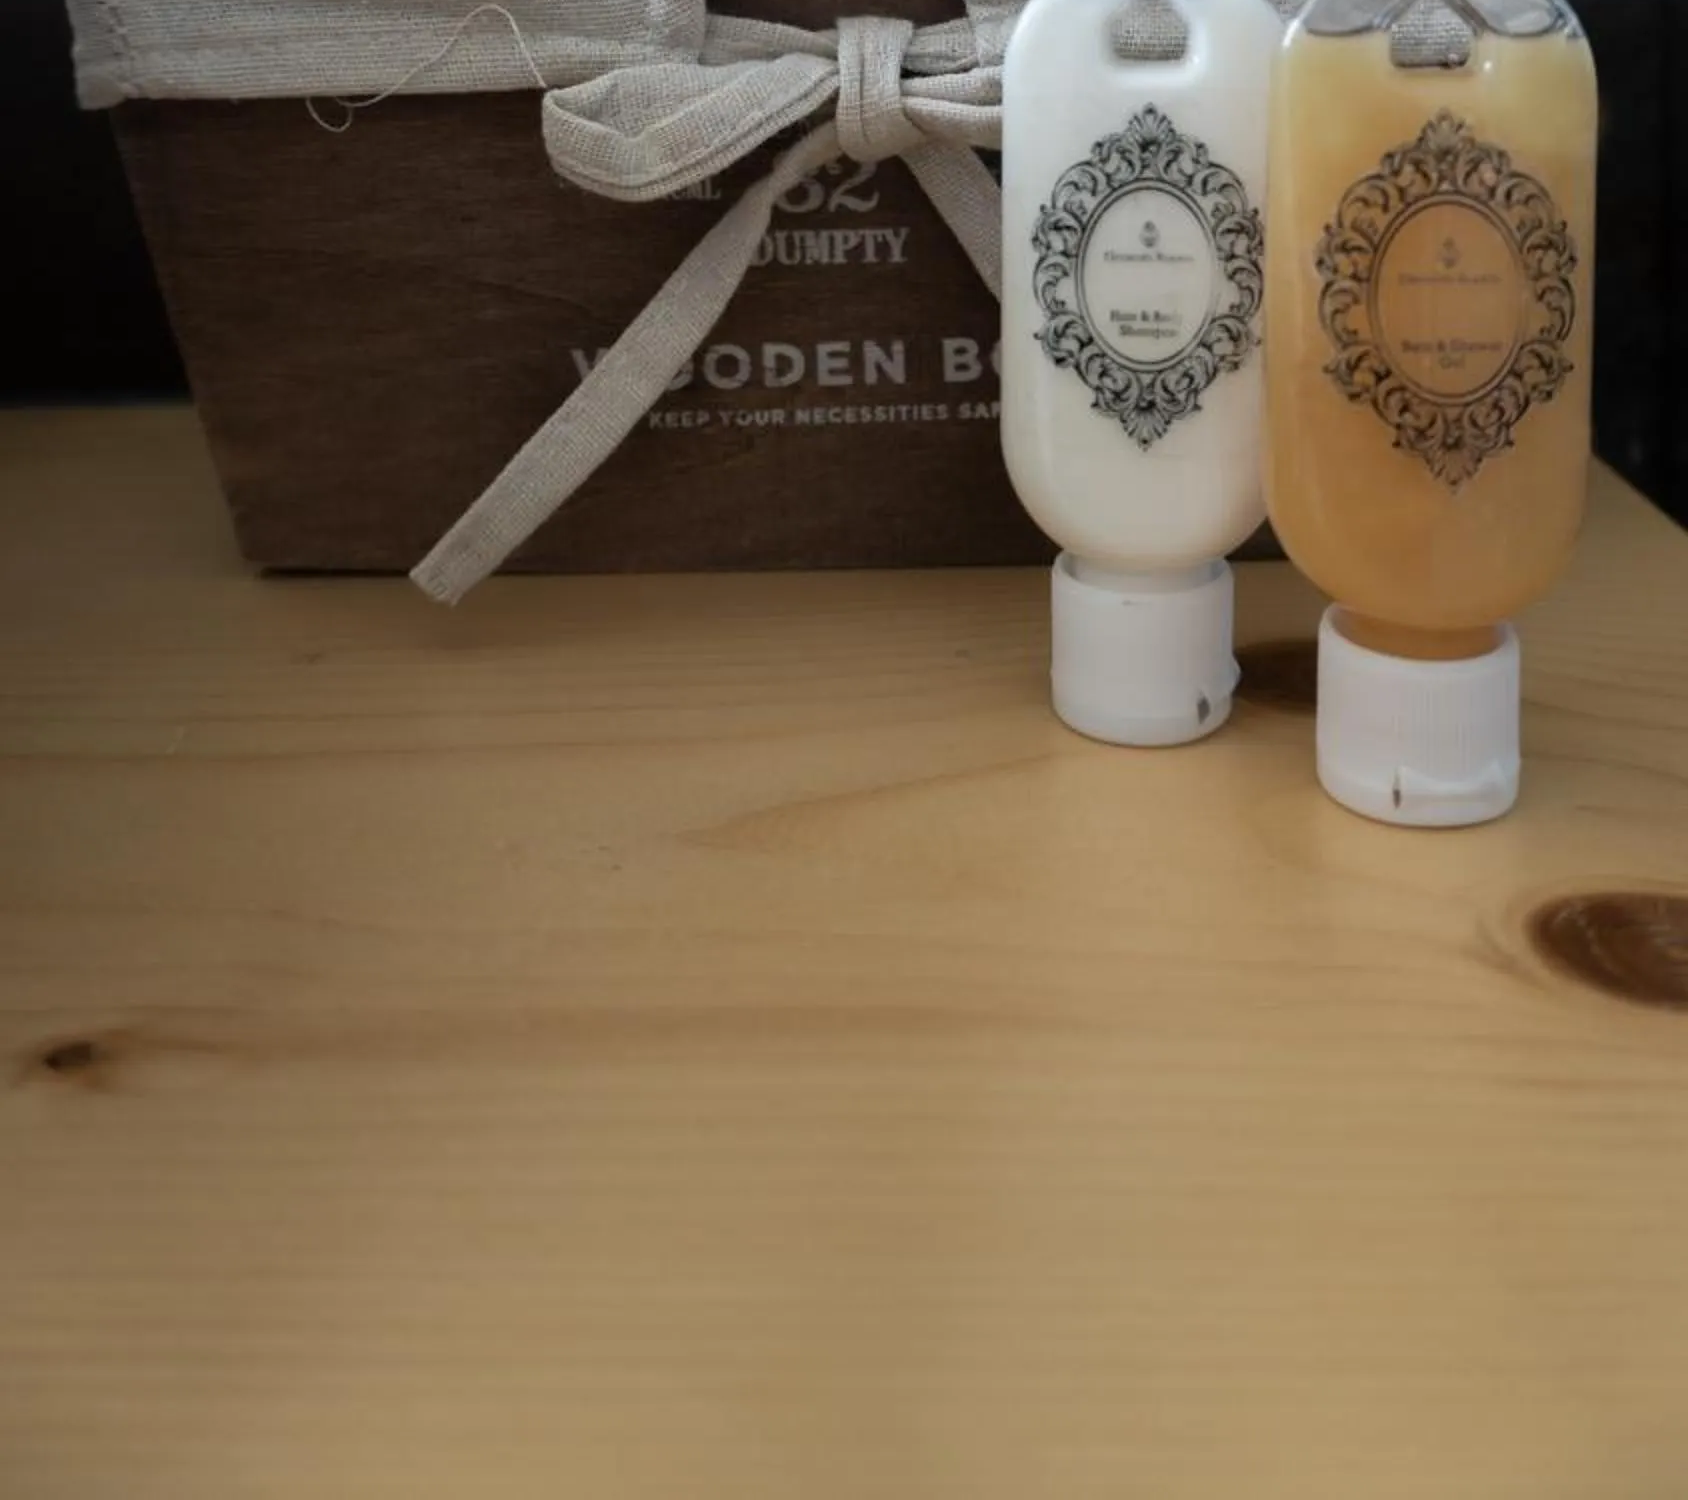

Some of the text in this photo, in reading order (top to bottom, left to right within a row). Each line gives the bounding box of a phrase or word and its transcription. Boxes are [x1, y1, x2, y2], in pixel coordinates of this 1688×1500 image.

[570, 339, 906, 390] ODEN
[649, 409, 710, 429] KEEP
[716, 407, 786, 427] YOUR
[795, 403, 948, 425] NECESSITIES
